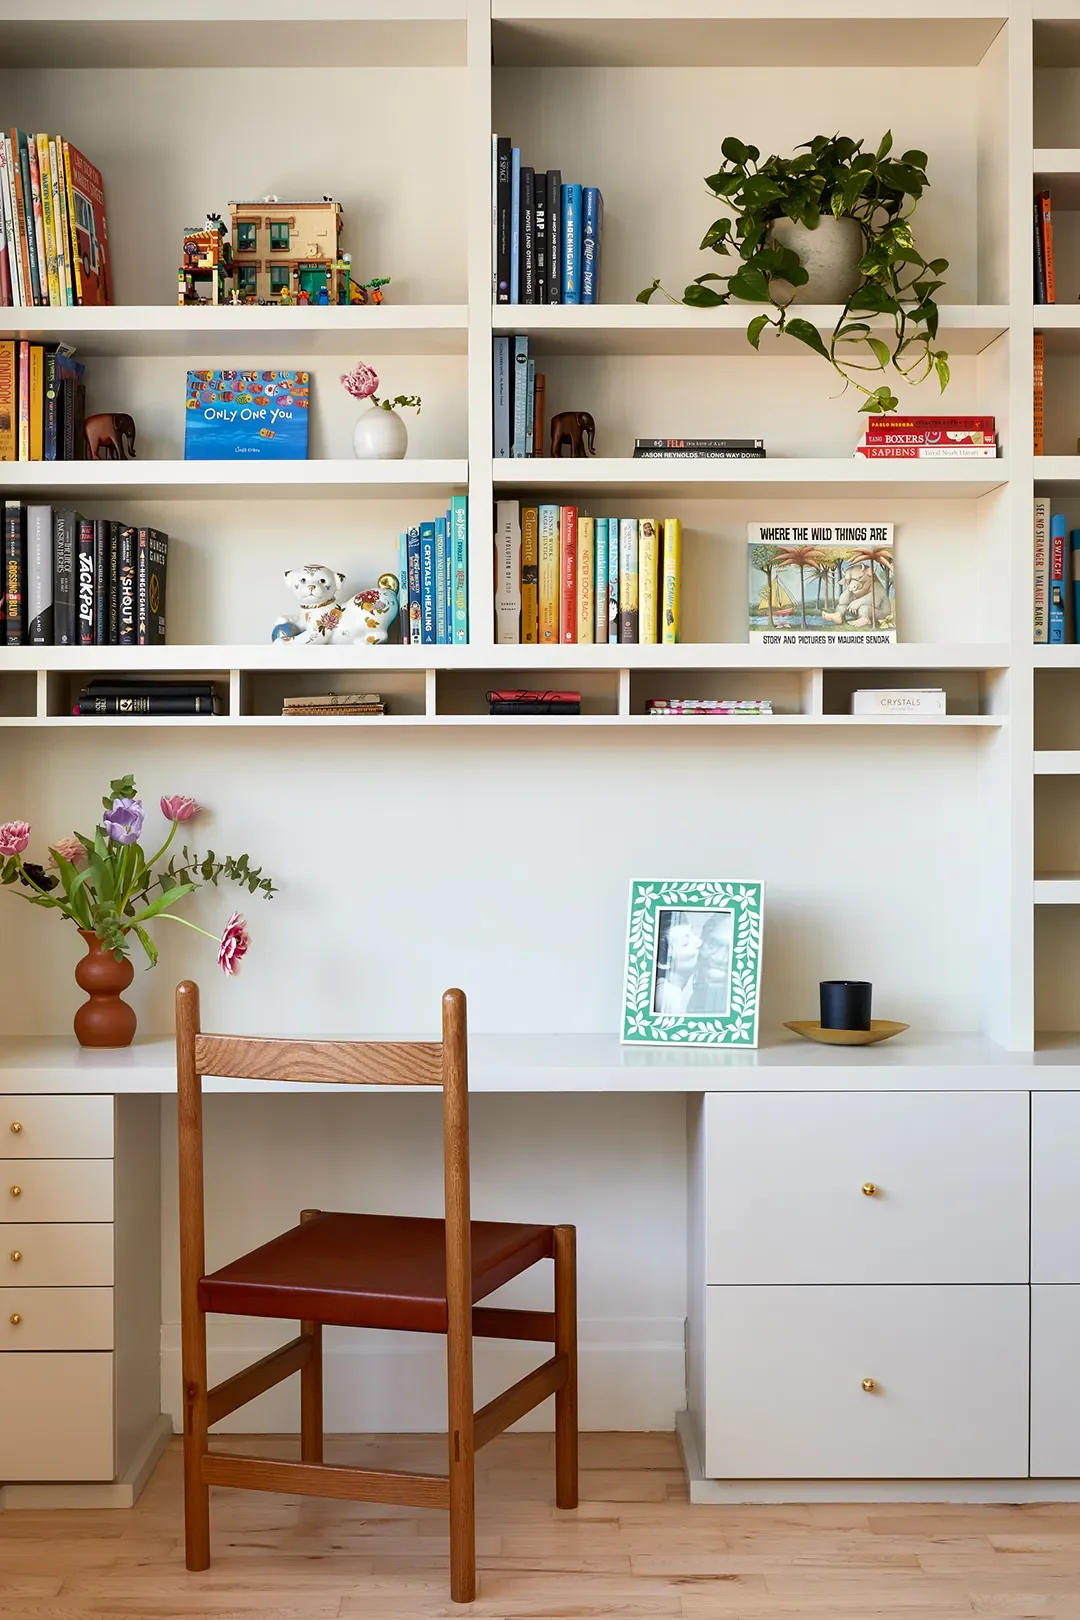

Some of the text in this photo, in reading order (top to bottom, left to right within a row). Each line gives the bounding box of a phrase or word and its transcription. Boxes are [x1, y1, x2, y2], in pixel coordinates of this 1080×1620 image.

[536, 210, 544, 229] RAP
[584, 238, 594, 259] CHILD
[584, 271, 592, 295] DREAM
[885, 435, 924, 443] BOXERS
[760, 527, 887, 540] WHERE THE WILD THINGS ARE
[1036, 518, 1044, 528] NO
[150, 538, 167, 554] HUNGER
[524, 510, 536, 561] Clemente
[1036, 531, 1044, 566] STRANGER
[9, 560, 17, 593] CROSSING
[597, 540, 606, 627] Frankie and Amelia
[79, 552, 93, 626] JACKPOT
[667, 576, 675, 608] GETAWAY
[1035, 576, 1044, 604] VALARIE
[9, 600, 17, 616] BLVD
[122, 578, 132, 623] SHOUT
[1035, 606, 1043, 626] KAUR
[763, 636, 890, 644] STORY AND PICTURES BY MAURICE SENDAK
